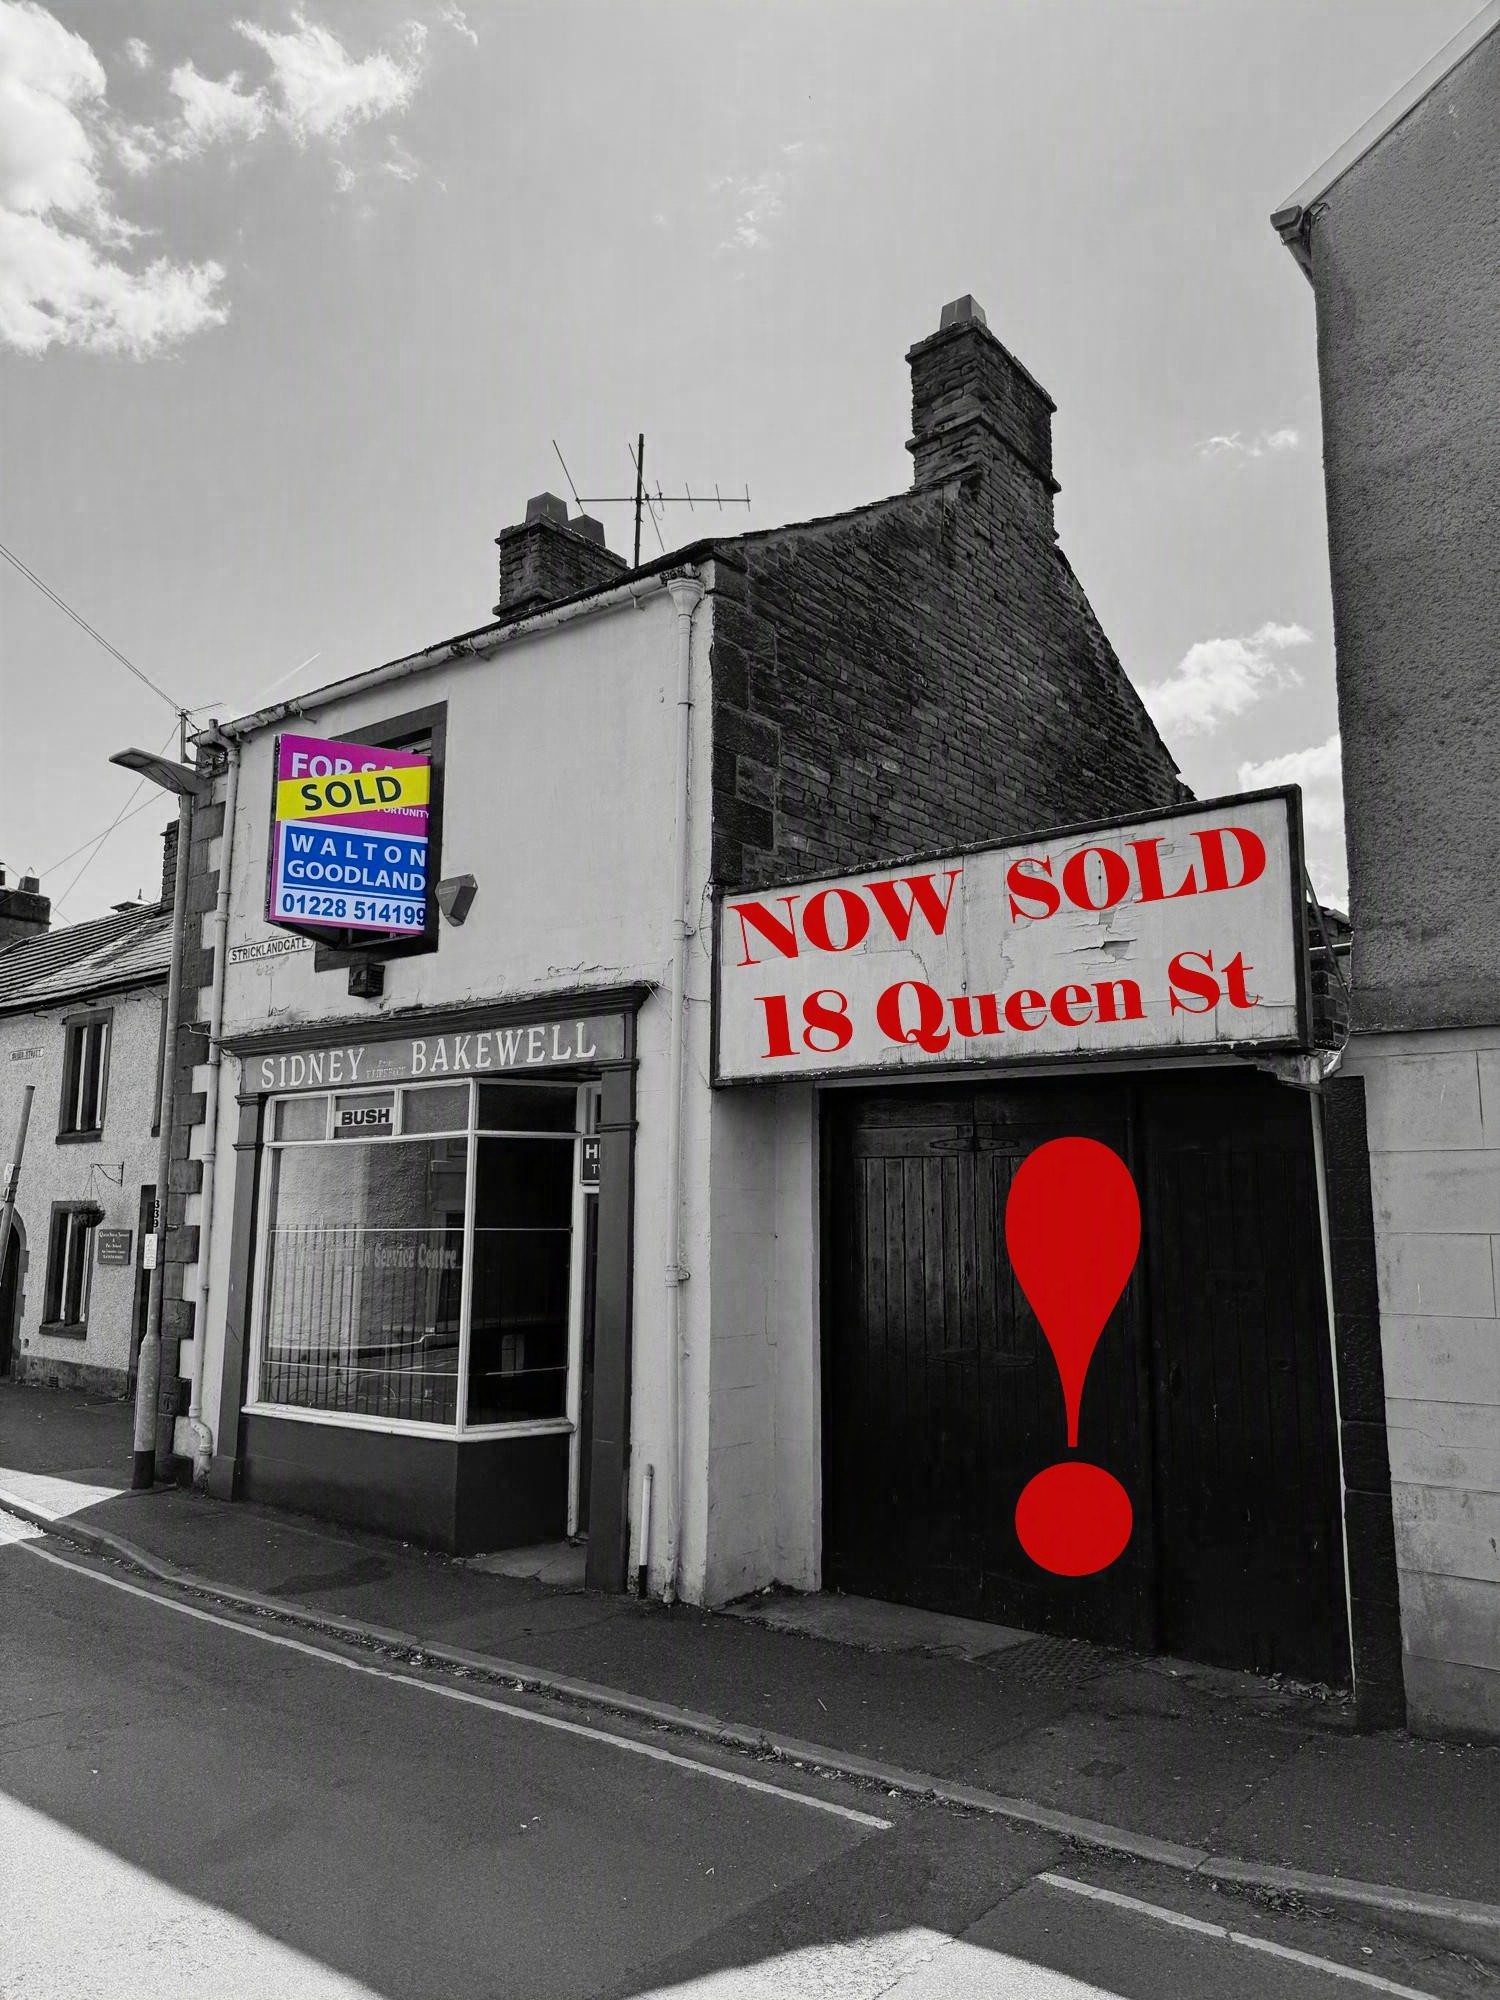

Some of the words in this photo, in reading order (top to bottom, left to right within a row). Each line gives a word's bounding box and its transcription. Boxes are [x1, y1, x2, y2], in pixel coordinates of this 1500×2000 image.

[291, 752, 353, 779] FOR
[301, 776, 402, 811] SOLD
[377, 807, 430, 819] ORTUNITY
[287, 859, 426, 891] GOODLAND
[282, 893, 347, 918] 01228
[353, 901, 426, 926] 514199
[261, 1047, 365, 1088] SIDNEY
[411, 1021, 597, 1074] BAKEWELL
[341, 1108, 390, 1126] BUSH
[585, 1143, 601, 1159] H
[374, 1242, 416, 1268] Service
[418, 1243, 457, 1269] Centre
